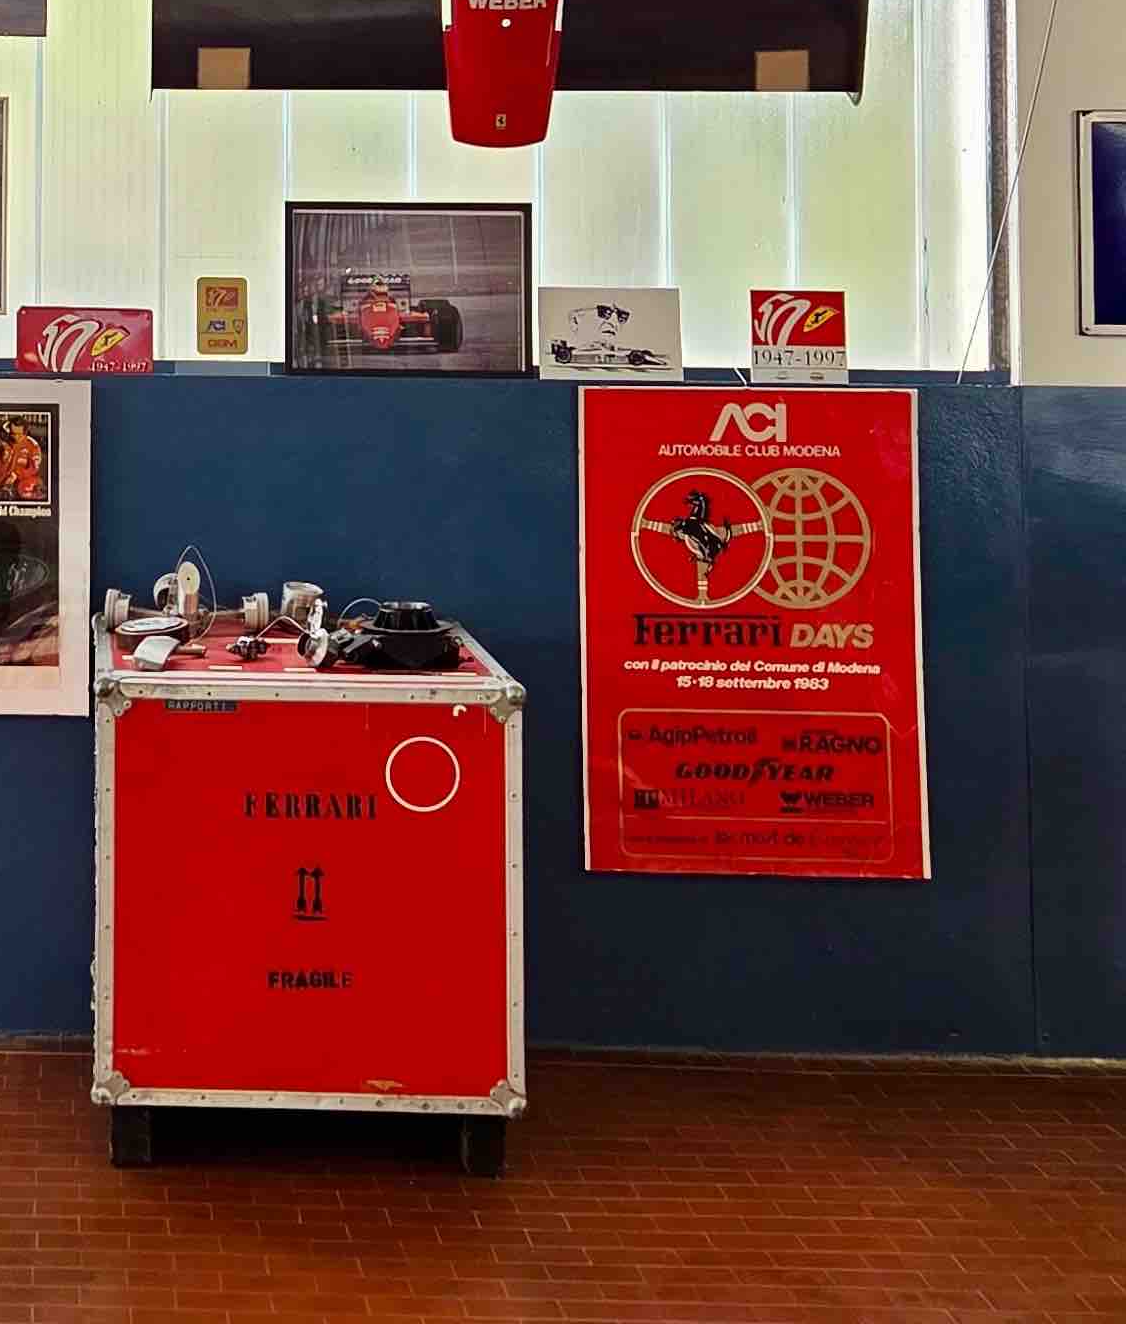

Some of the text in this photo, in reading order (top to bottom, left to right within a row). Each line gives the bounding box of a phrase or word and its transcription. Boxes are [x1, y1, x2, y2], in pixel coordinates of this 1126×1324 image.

[752, 349, 846, 367] 1947-1997
[709, 402, 787, 443] ACI
[658, 443, 842, 458] AUTOMOBILE CLUB MODENA
[633, 613, 875, 649] Ferrari DAYS
[624, 659, 649, 671] con
[660, 659, 728, 674] patrocinio
[730, 660, 751, 672] del
[753, 660, 810, 674] Comune
[812, 661, 826, 673] di
[827, 661, 882, 675] Modena
[715, 677, 792, 690] settembre
[793, 678, 830, 691] 1983
[243, 791, 379, 820] FERRARI
[268, 971, 354, 990] FRAGILE
